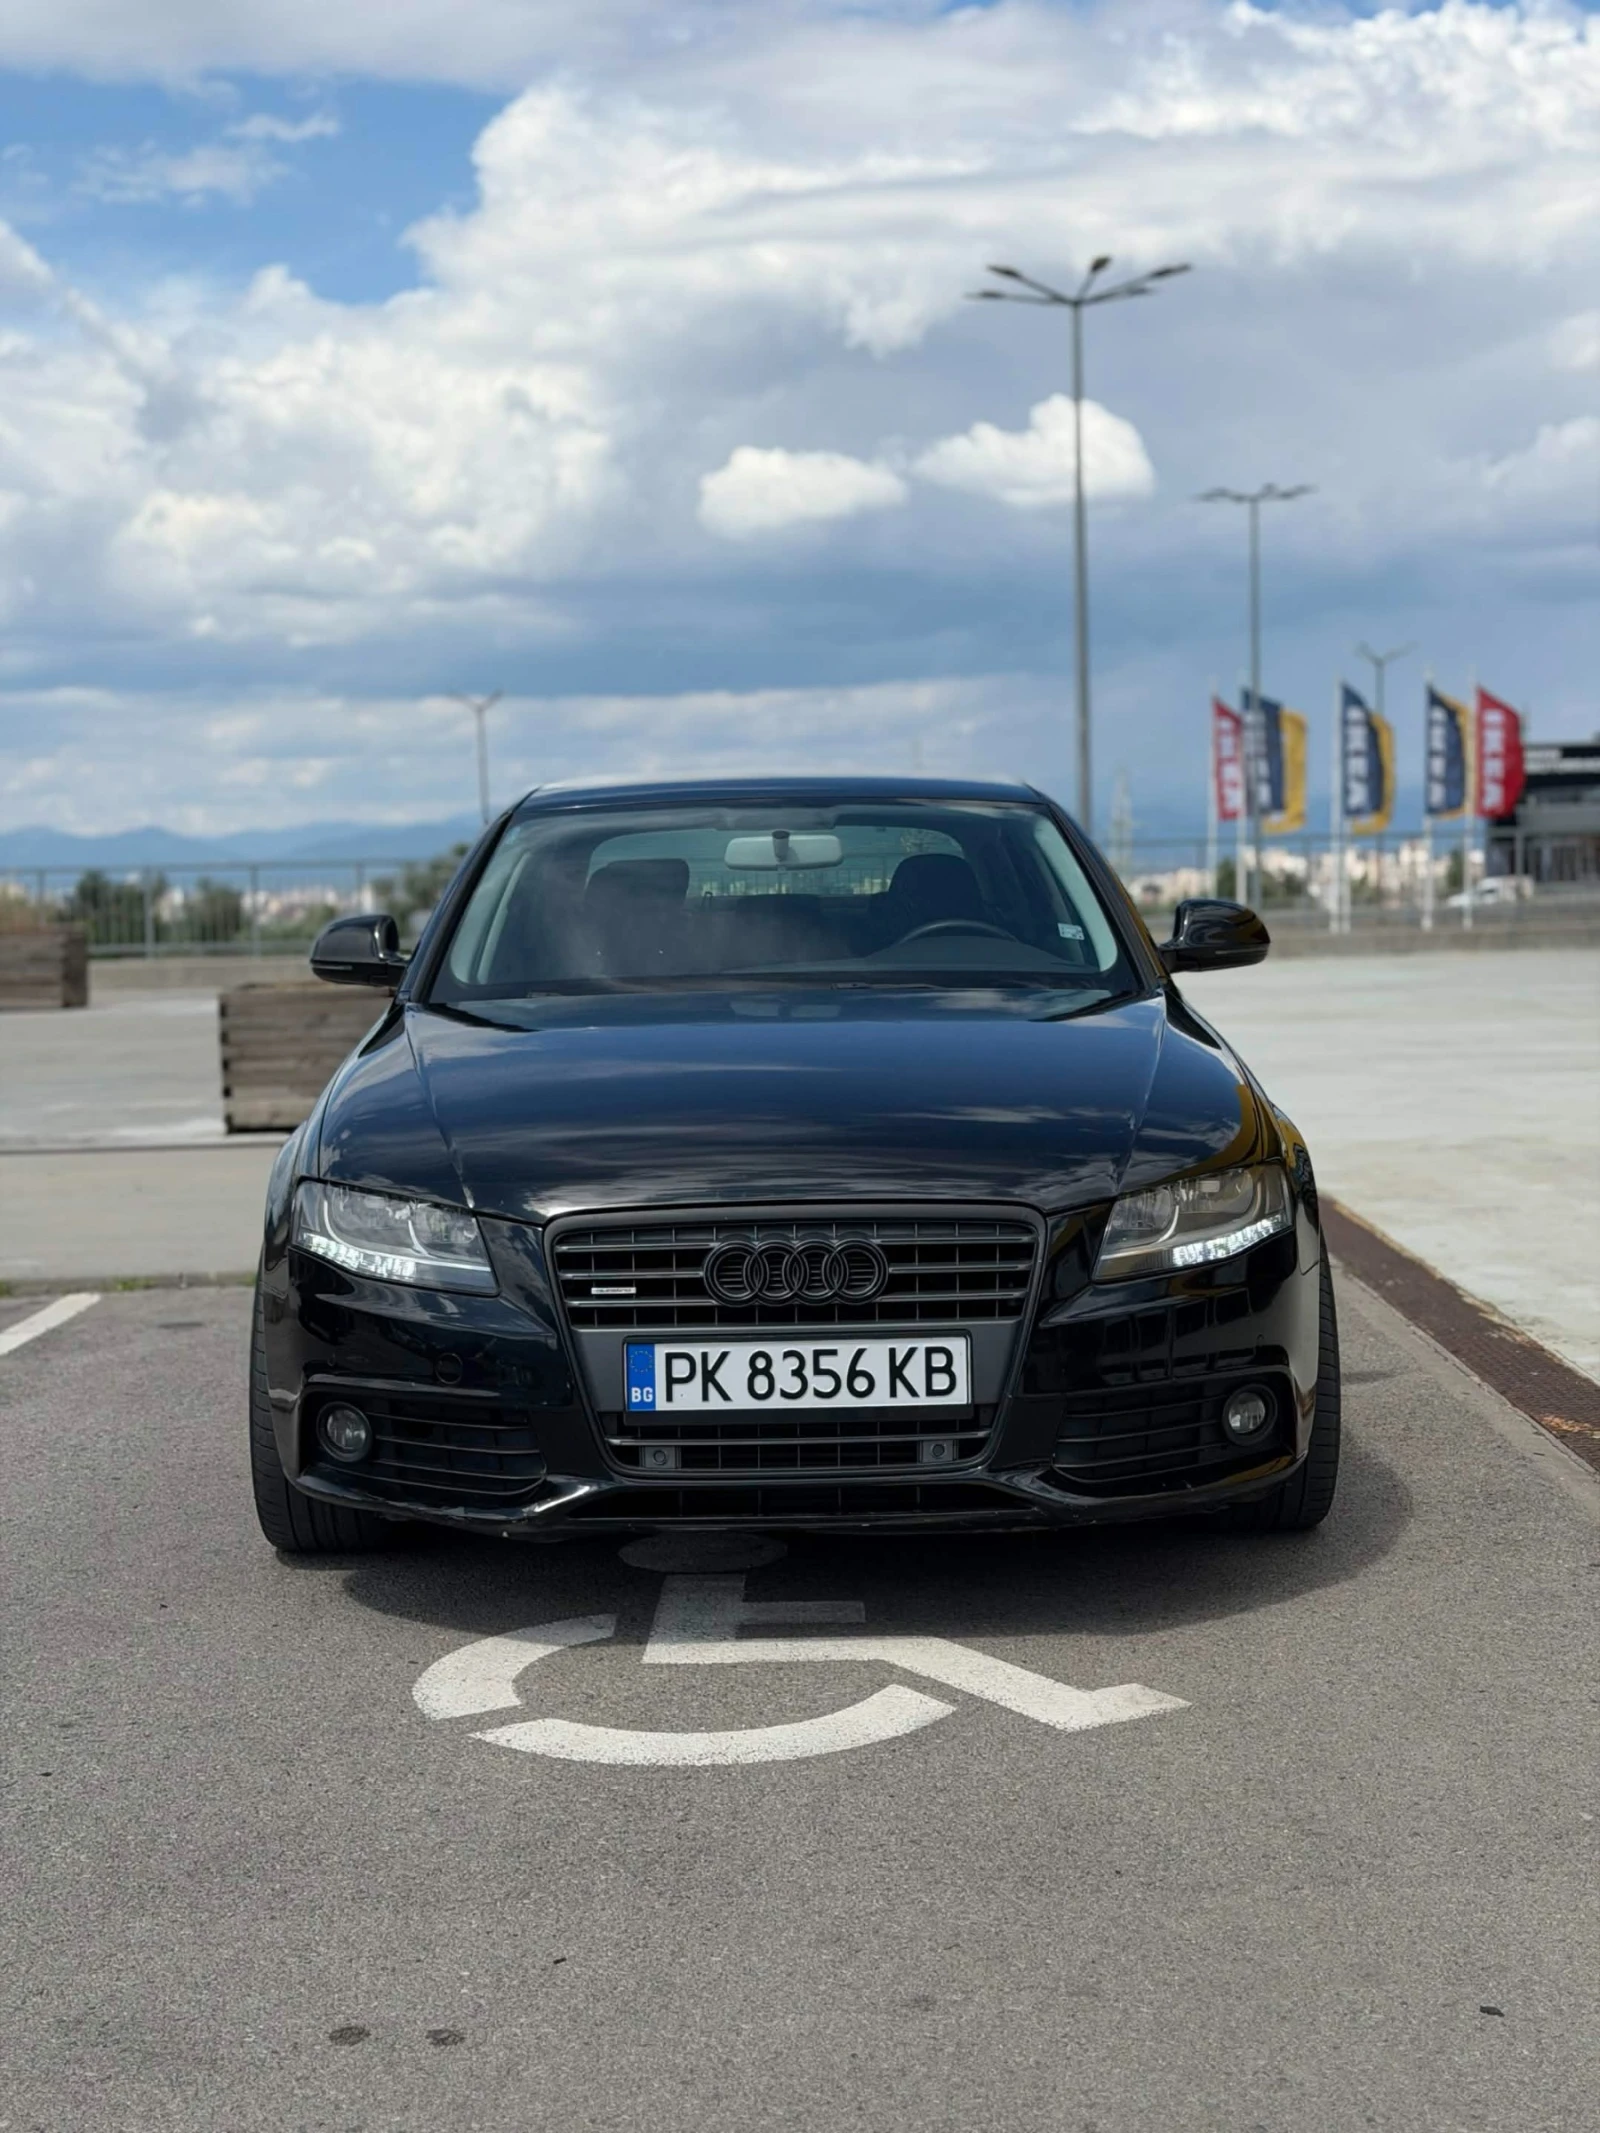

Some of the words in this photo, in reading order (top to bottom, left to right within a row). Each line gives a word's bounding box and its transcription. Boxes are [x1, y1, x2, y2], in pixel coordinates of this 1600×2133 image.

[664, 1351, 733, 1403] PK
[746, 1348, 876, 1400] 8356
[888, 1346, 957, 1398] KB
[631, 1387, 653, 1403] BG
